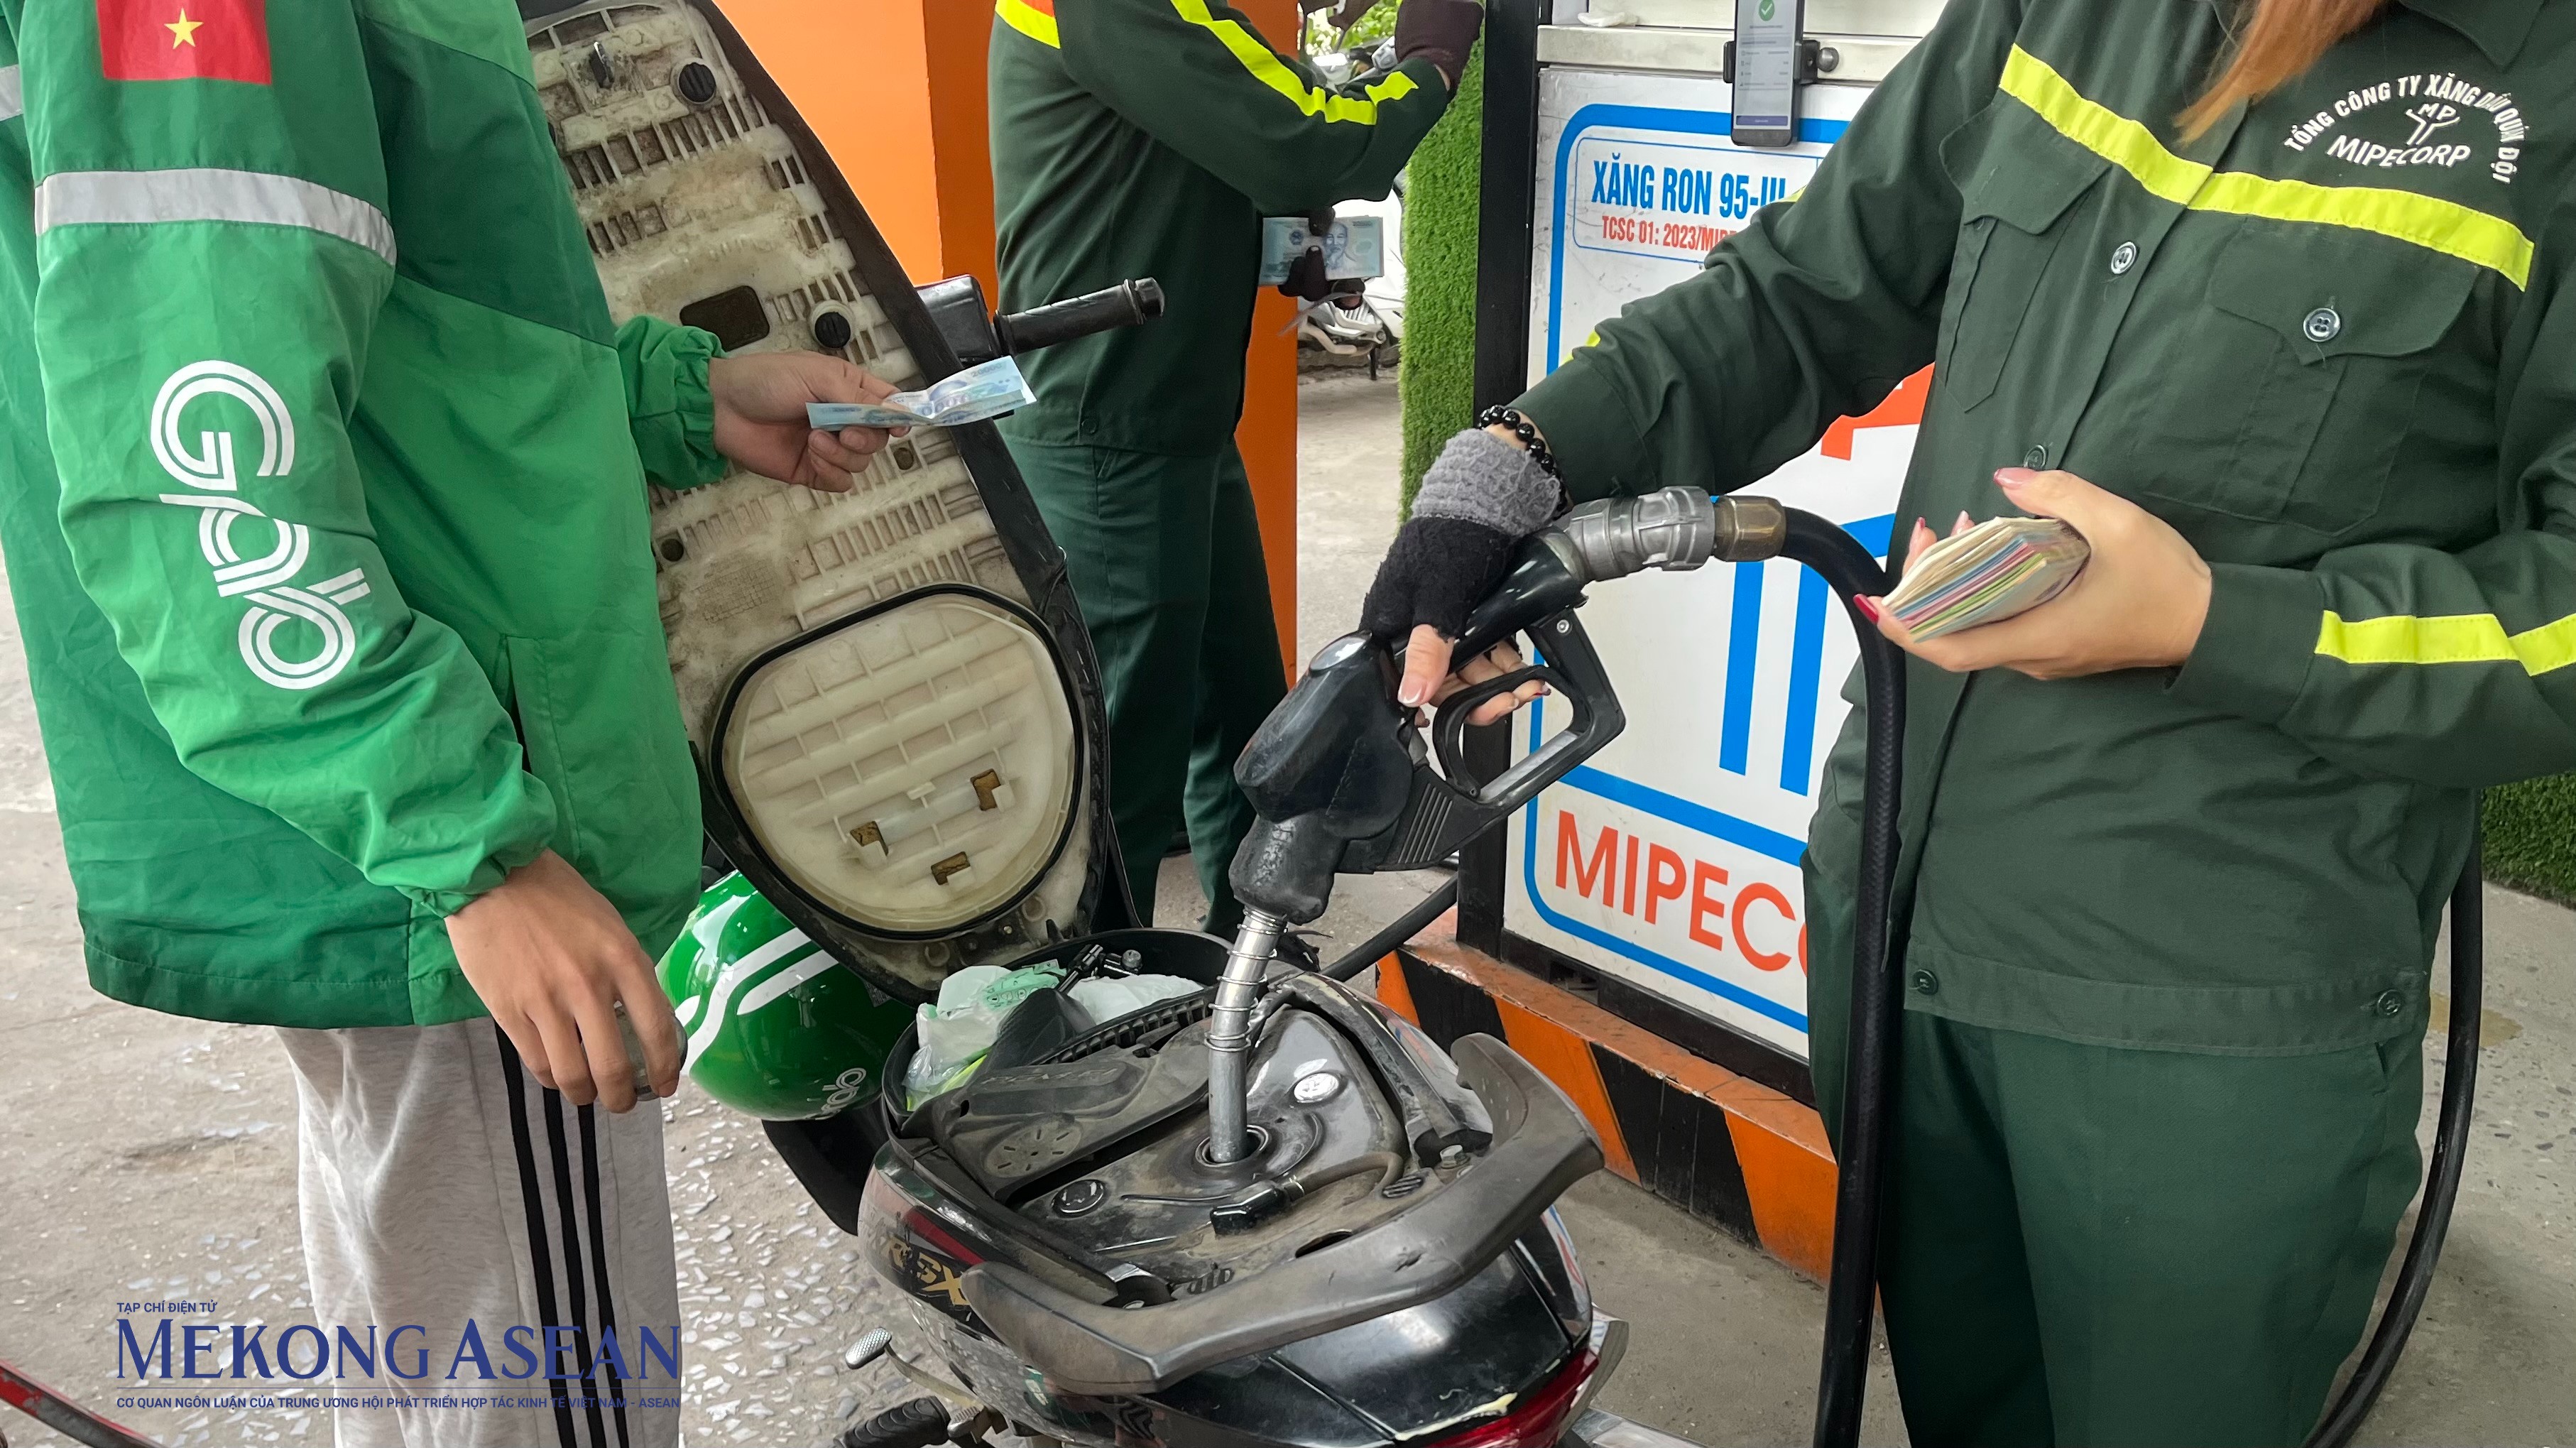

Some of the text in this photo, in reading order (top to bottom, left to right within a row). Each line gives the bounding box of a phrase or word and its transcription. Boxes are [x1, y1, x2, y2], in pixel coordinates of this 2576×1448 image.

[2284, 111, 2335, 151] TỔNG
[2335, 82, 2391, 118] CÔNG
[2398, 75, 2422, 98] TY
[2423, 72, 2481, 107] XĂNG
[2418, 103, 2457, 121] MP
[2327, 134, 2472, 168] MIPECORP
[1591, 153, 1655, 210] XĂNG
[1661, 166, 1713, 216] RON
[1602, 215, 1635, 242] TCSC
[1639, 220, 1659, 246] 01:
[151, 359, 371, 690] Grab
